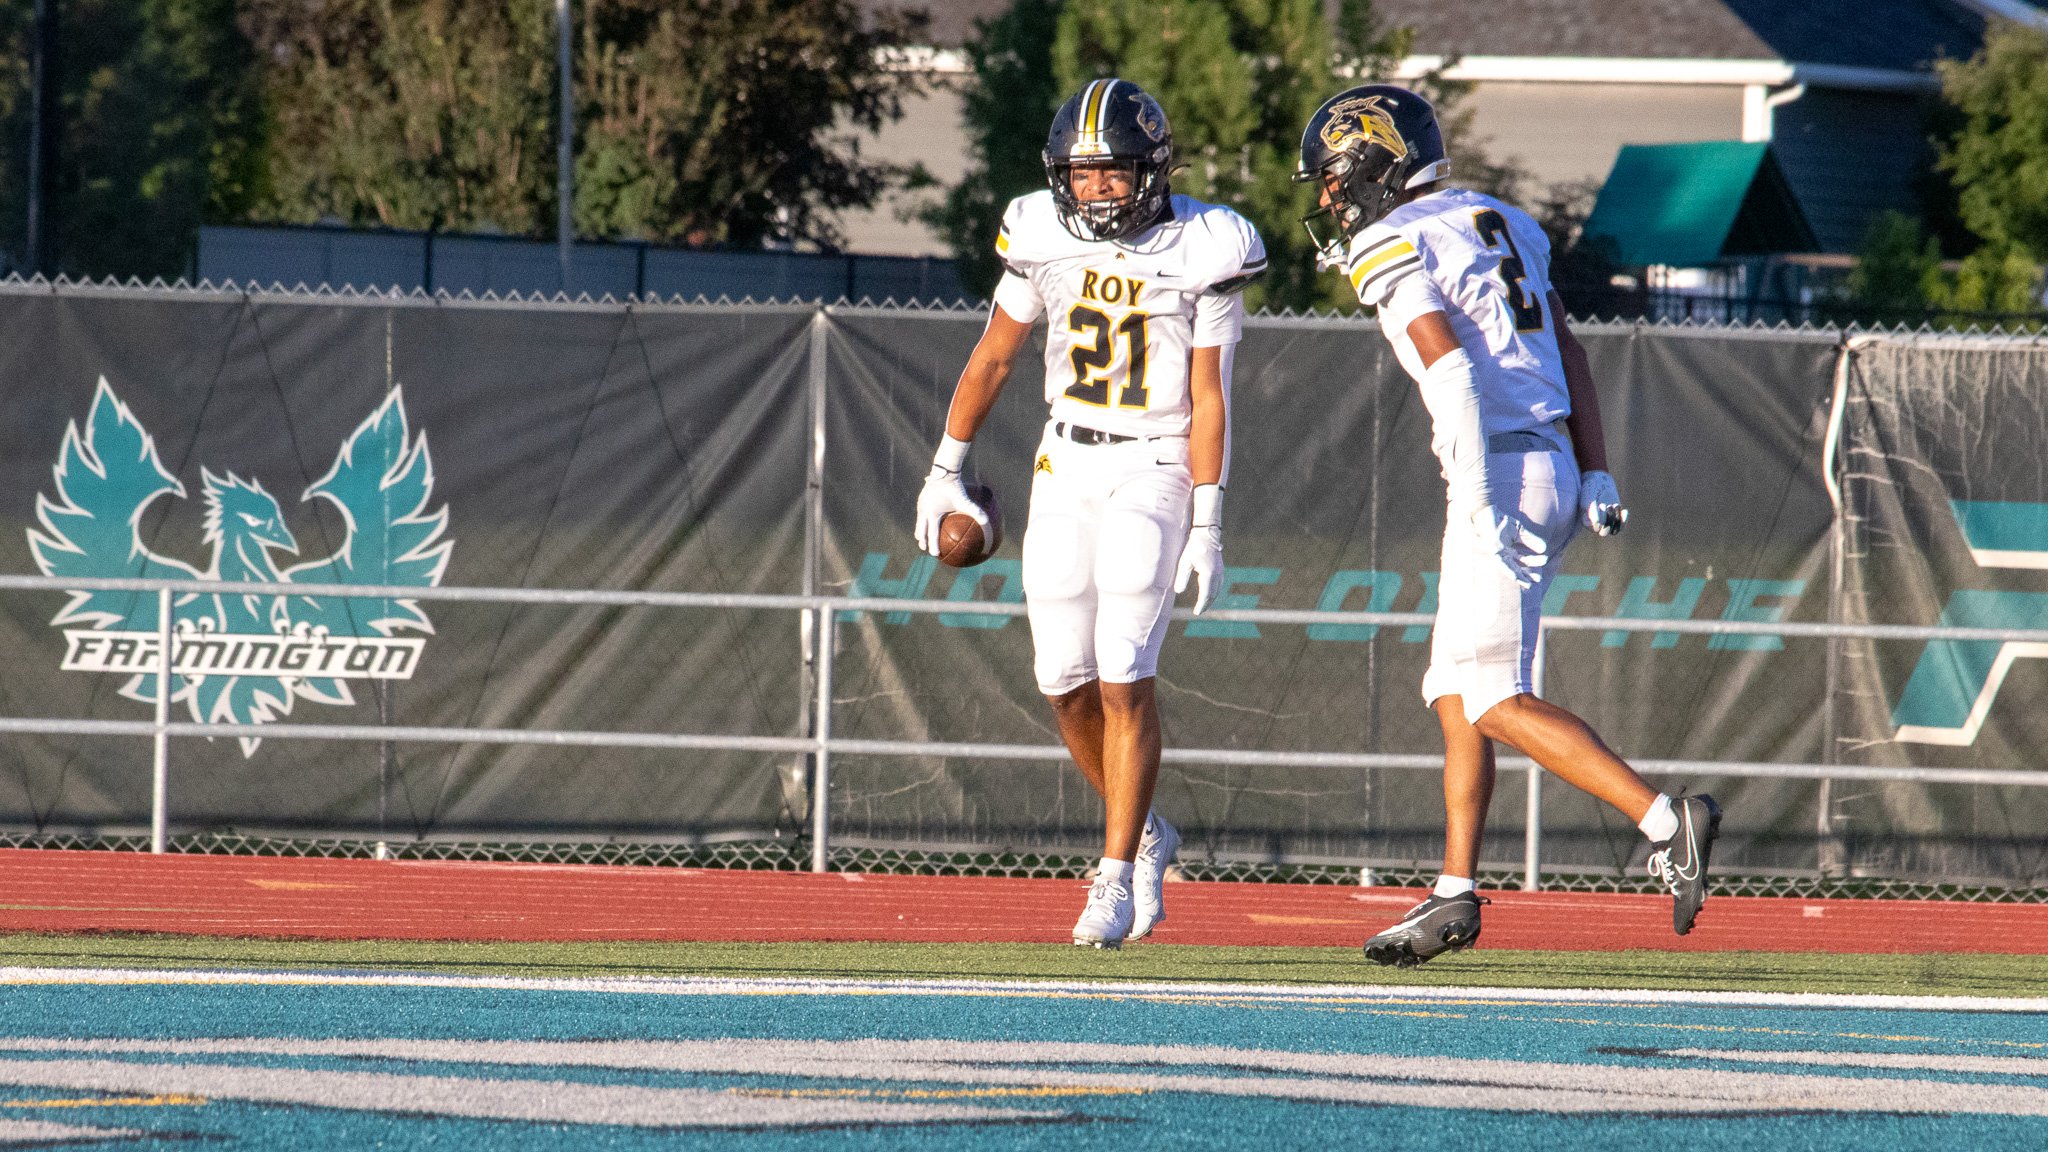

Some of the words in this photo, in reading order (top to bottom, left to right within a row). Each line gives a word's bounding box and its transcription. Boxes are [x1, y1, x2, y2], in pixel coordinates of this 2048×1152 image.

[1082, 268, 1146, 307] ROY
[1472, 208, 1544, 333] 2
[1064, 302, 1150, 410] 21
[836, 552, 1282, 639] HOE
